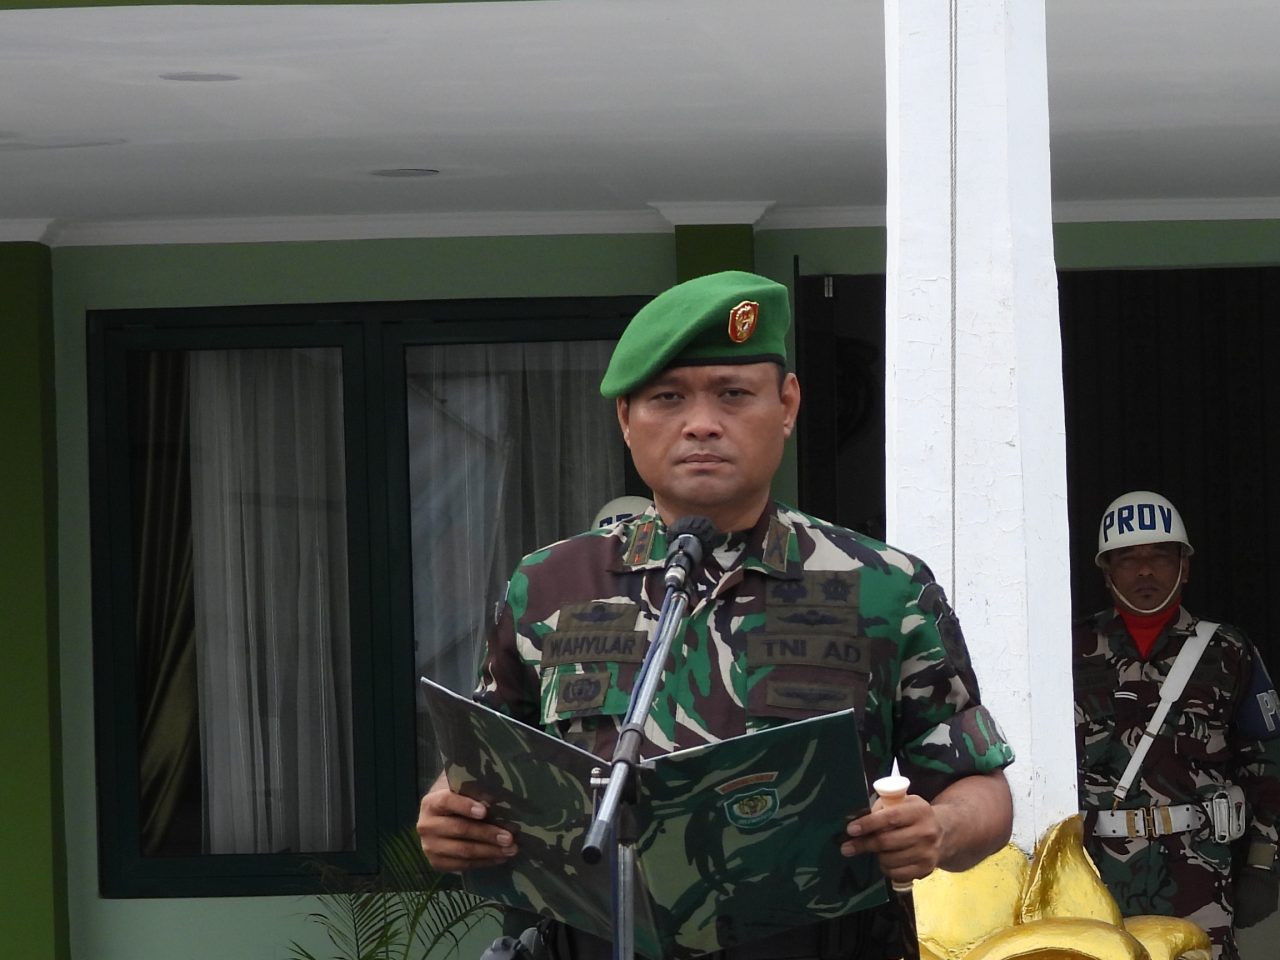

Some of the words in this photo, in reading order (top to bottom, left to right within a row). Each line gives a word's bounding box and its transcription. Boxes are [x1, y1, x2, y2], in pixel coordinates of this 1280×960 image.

[1103, 504, 1172, 543] PROV
[761, 639, 807, 657] TNI
[822, 641, 861, 663] AD
